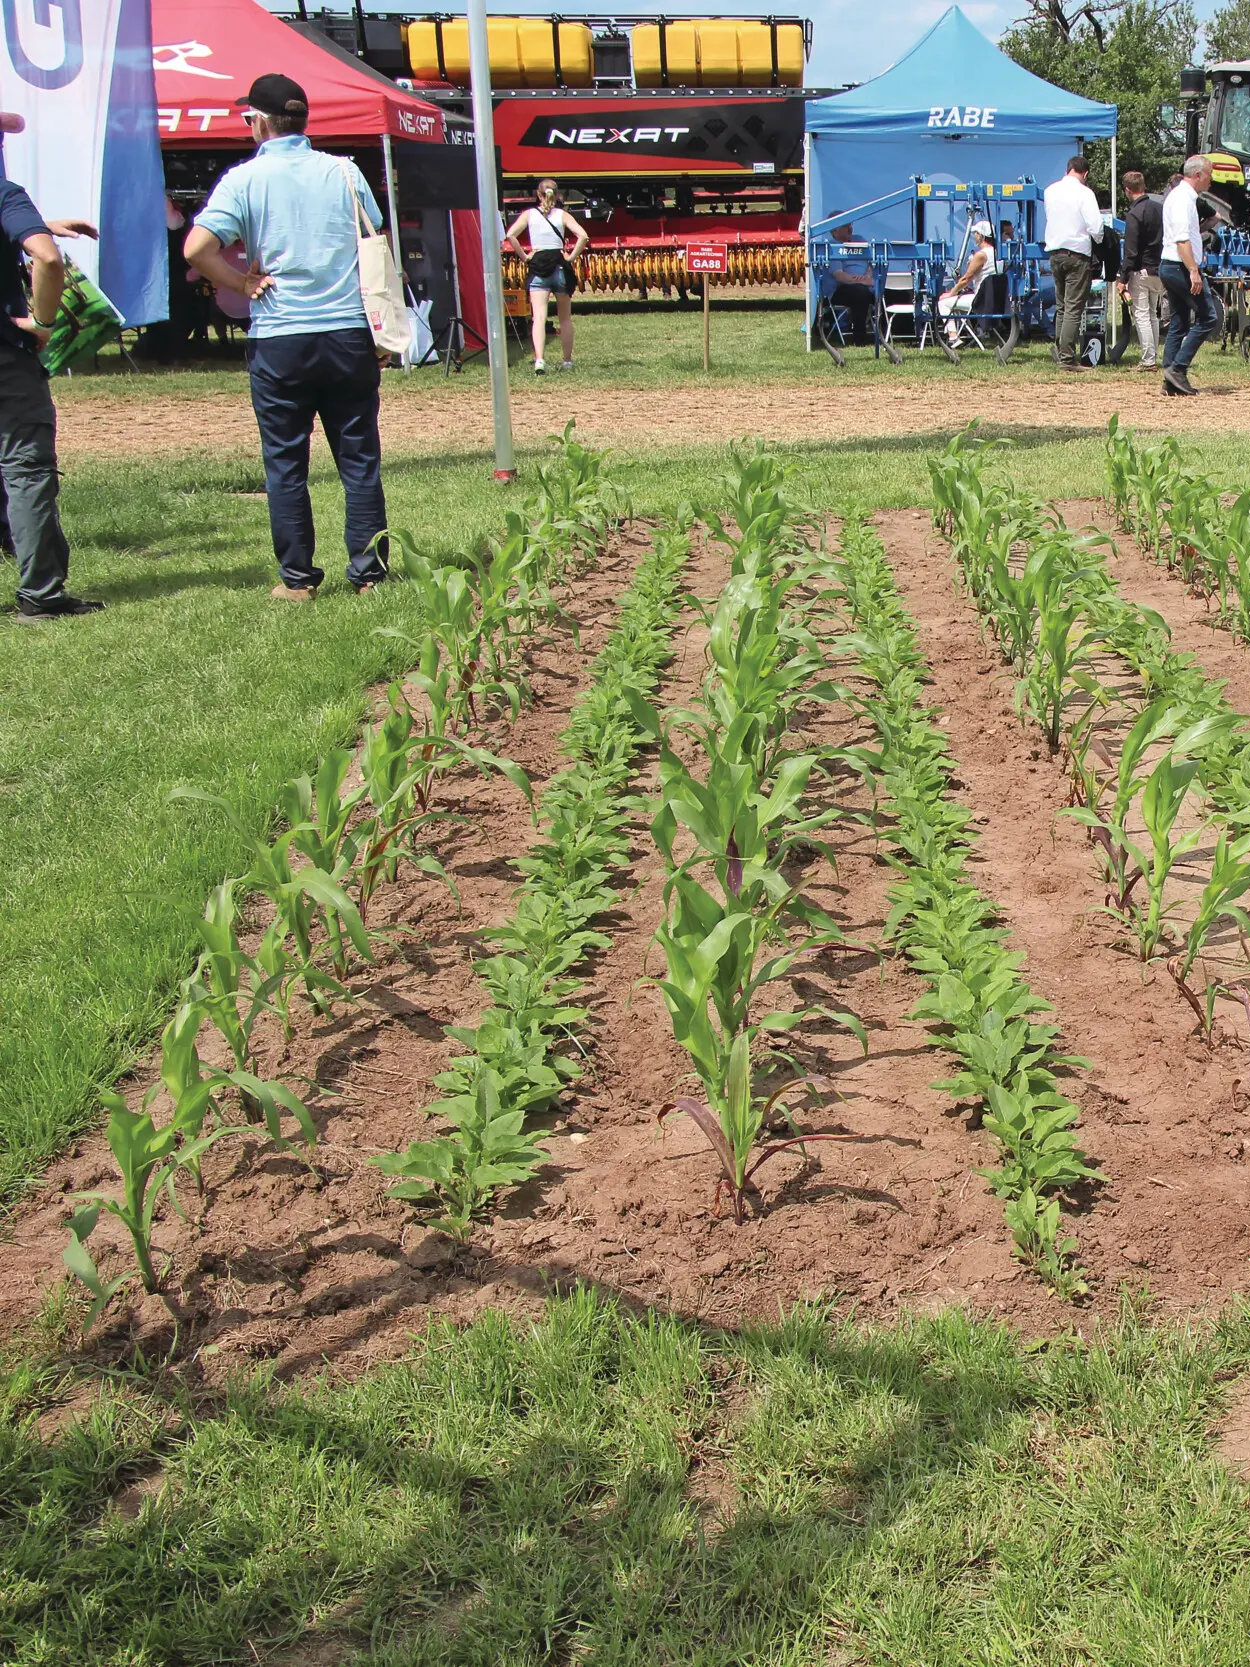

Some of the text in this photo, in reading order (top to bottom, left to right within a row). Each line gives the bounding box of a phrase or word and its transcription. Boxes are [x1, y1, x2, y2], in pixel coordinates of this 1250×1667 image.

[398, 109, 435, 136] NEXAT
[927, 106, 998, 128] RABE
[548, 127, 689, 144] NEXAT
[692, 259, 721, 269] GA88
